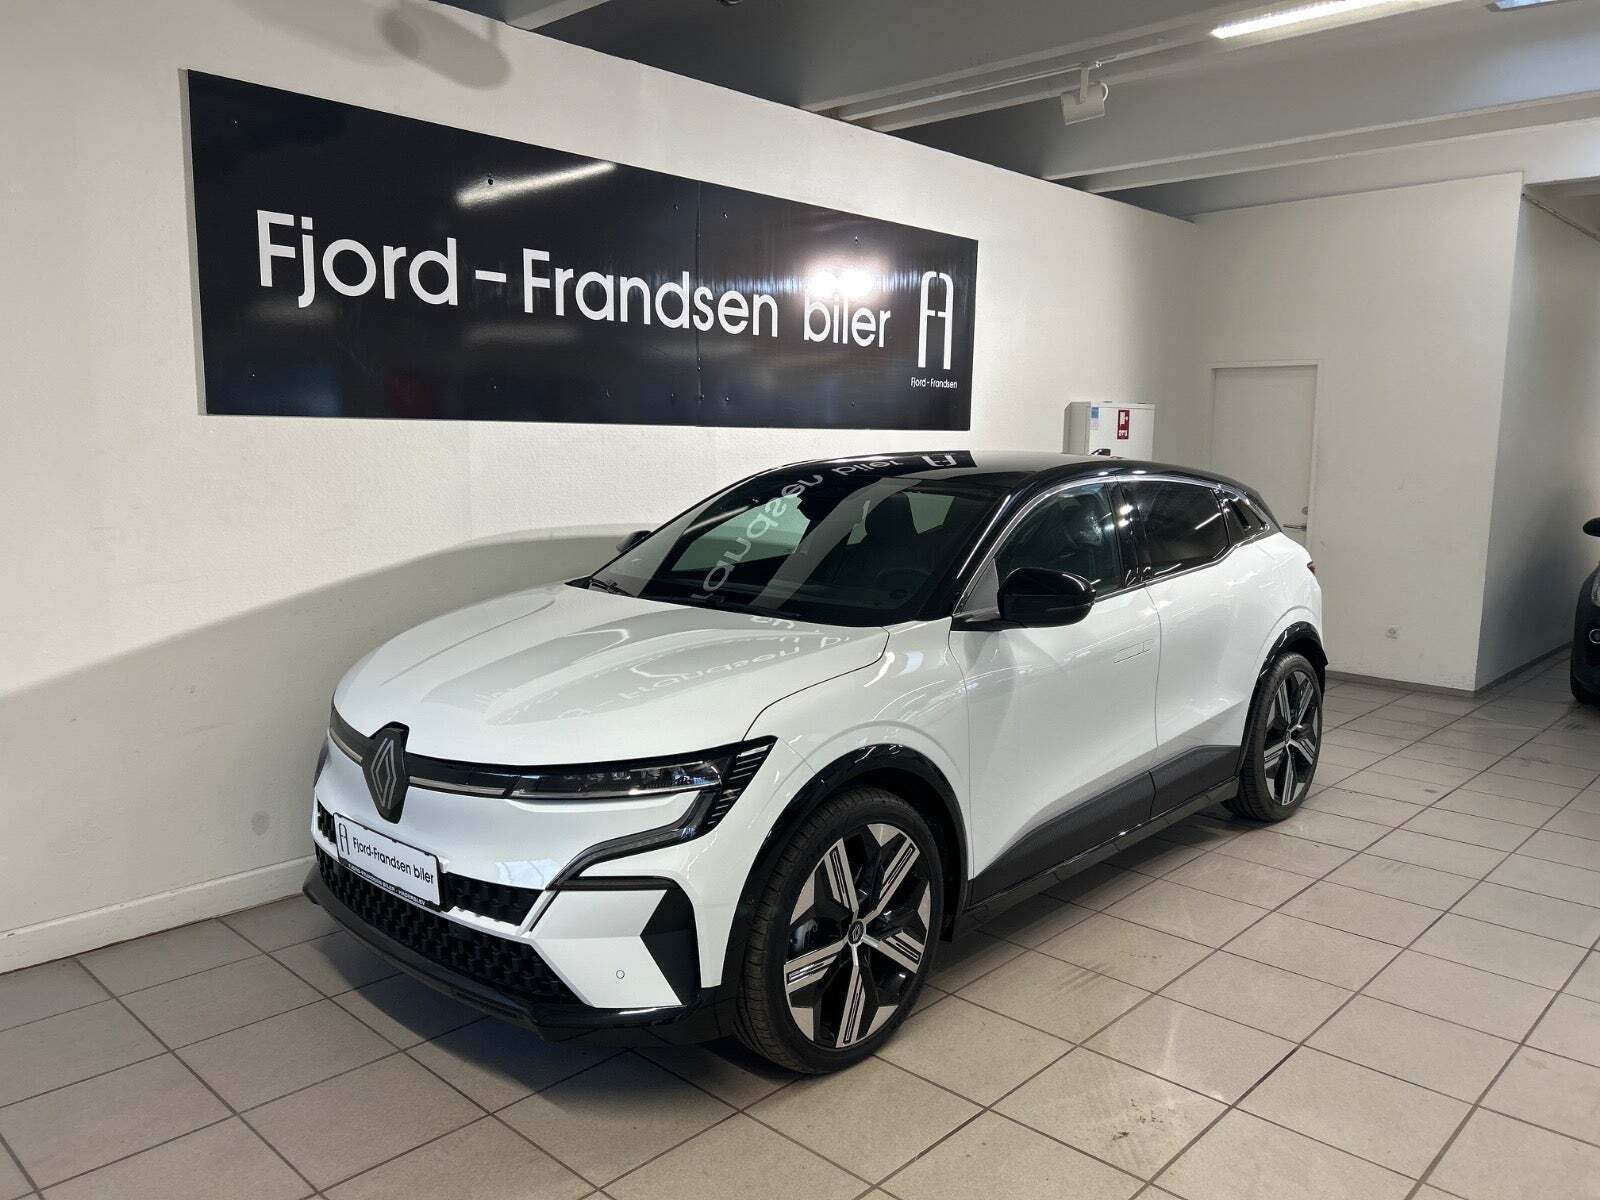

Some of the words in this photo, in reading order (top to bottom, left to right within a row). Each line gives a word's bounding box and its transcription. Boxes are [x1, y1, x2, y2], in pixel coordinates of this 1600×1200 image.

[255, 208, 458, 309] Fjord
[522, 248, 779, 339] Frandsen
[803, 287, 892, 348] biler
[910, 376, 927, 388] Fjord
[930, 378, 958, 389] Frandsen
[352, 836, 412, 876] Fjord-Frandsen
[413, 864, 434, 885] biler
